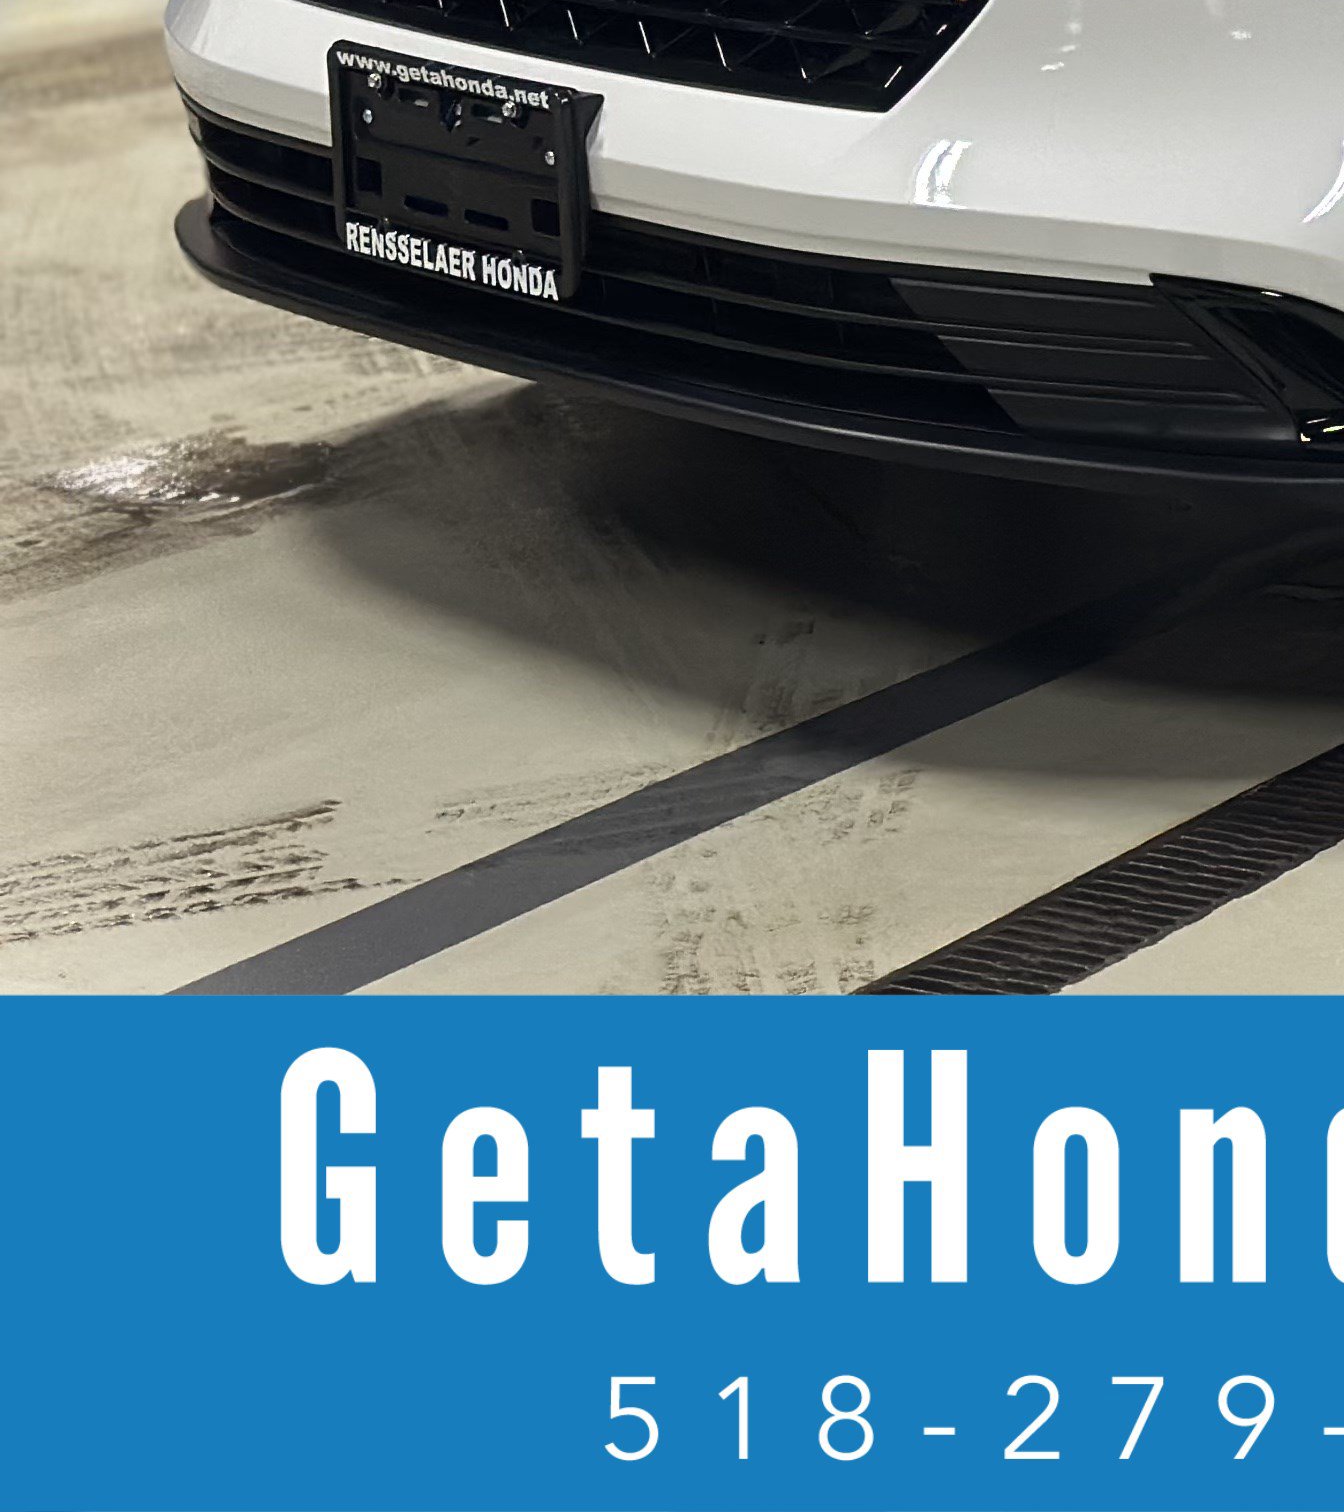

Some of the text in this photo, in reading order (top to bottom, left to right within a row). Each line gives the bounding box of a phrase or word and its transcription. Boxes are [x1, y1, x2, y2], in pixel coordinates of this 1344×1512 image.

[336, 51, 549, 109] www.getahonda.net
[346, 222, 559, 301] RENSSELAER HONDA
